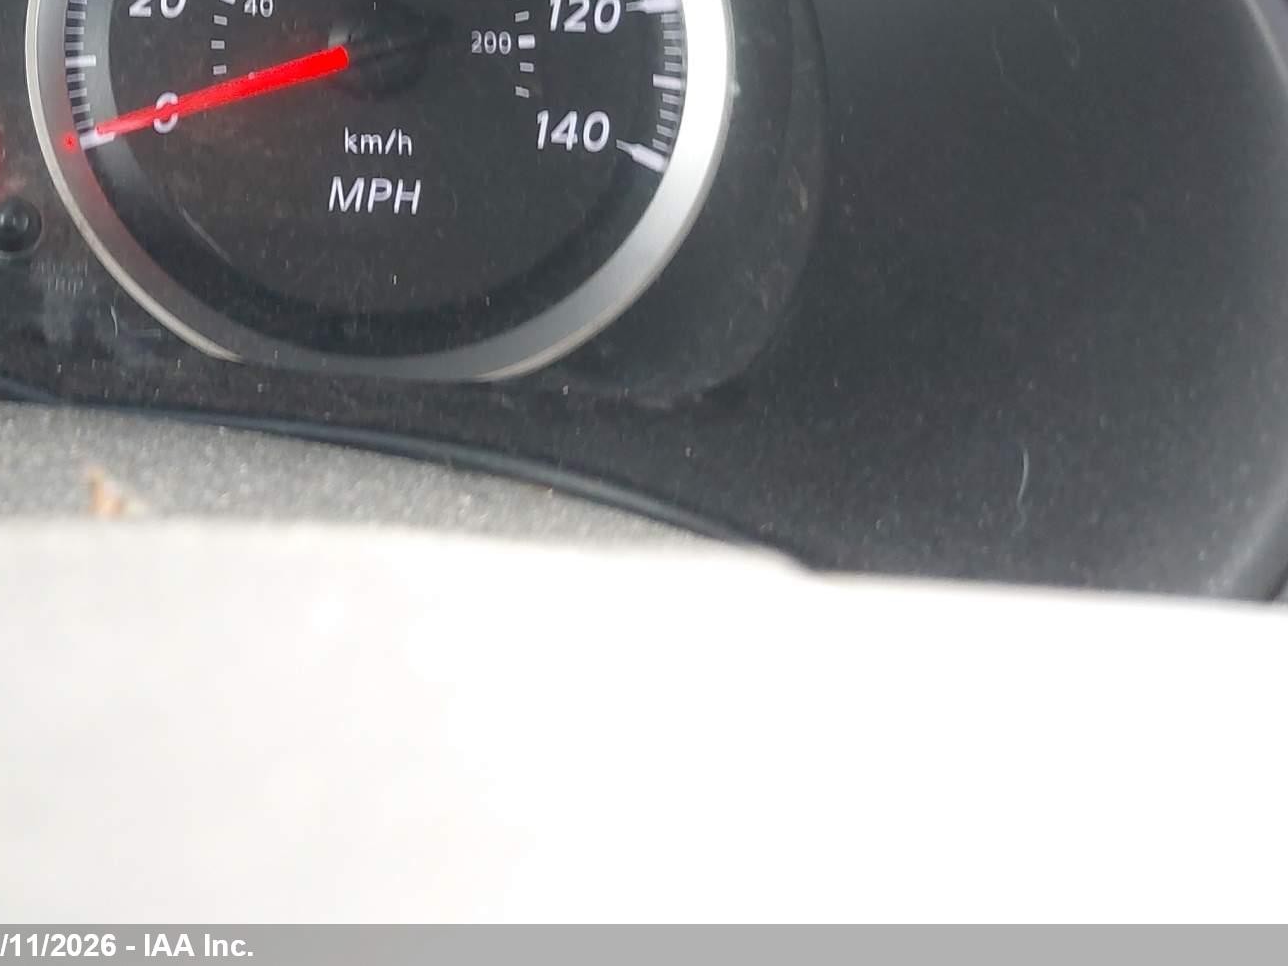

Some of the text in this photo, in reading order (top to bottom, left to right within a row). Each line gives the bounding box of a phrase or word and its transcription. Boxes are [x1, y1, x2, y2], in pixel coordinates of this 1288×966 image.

[471, 30, 512, 55] 200
[344, 126, 413, 156] km/h
[537, 110, 610, 152] 140
[328, 176, 422, 216] MPH
